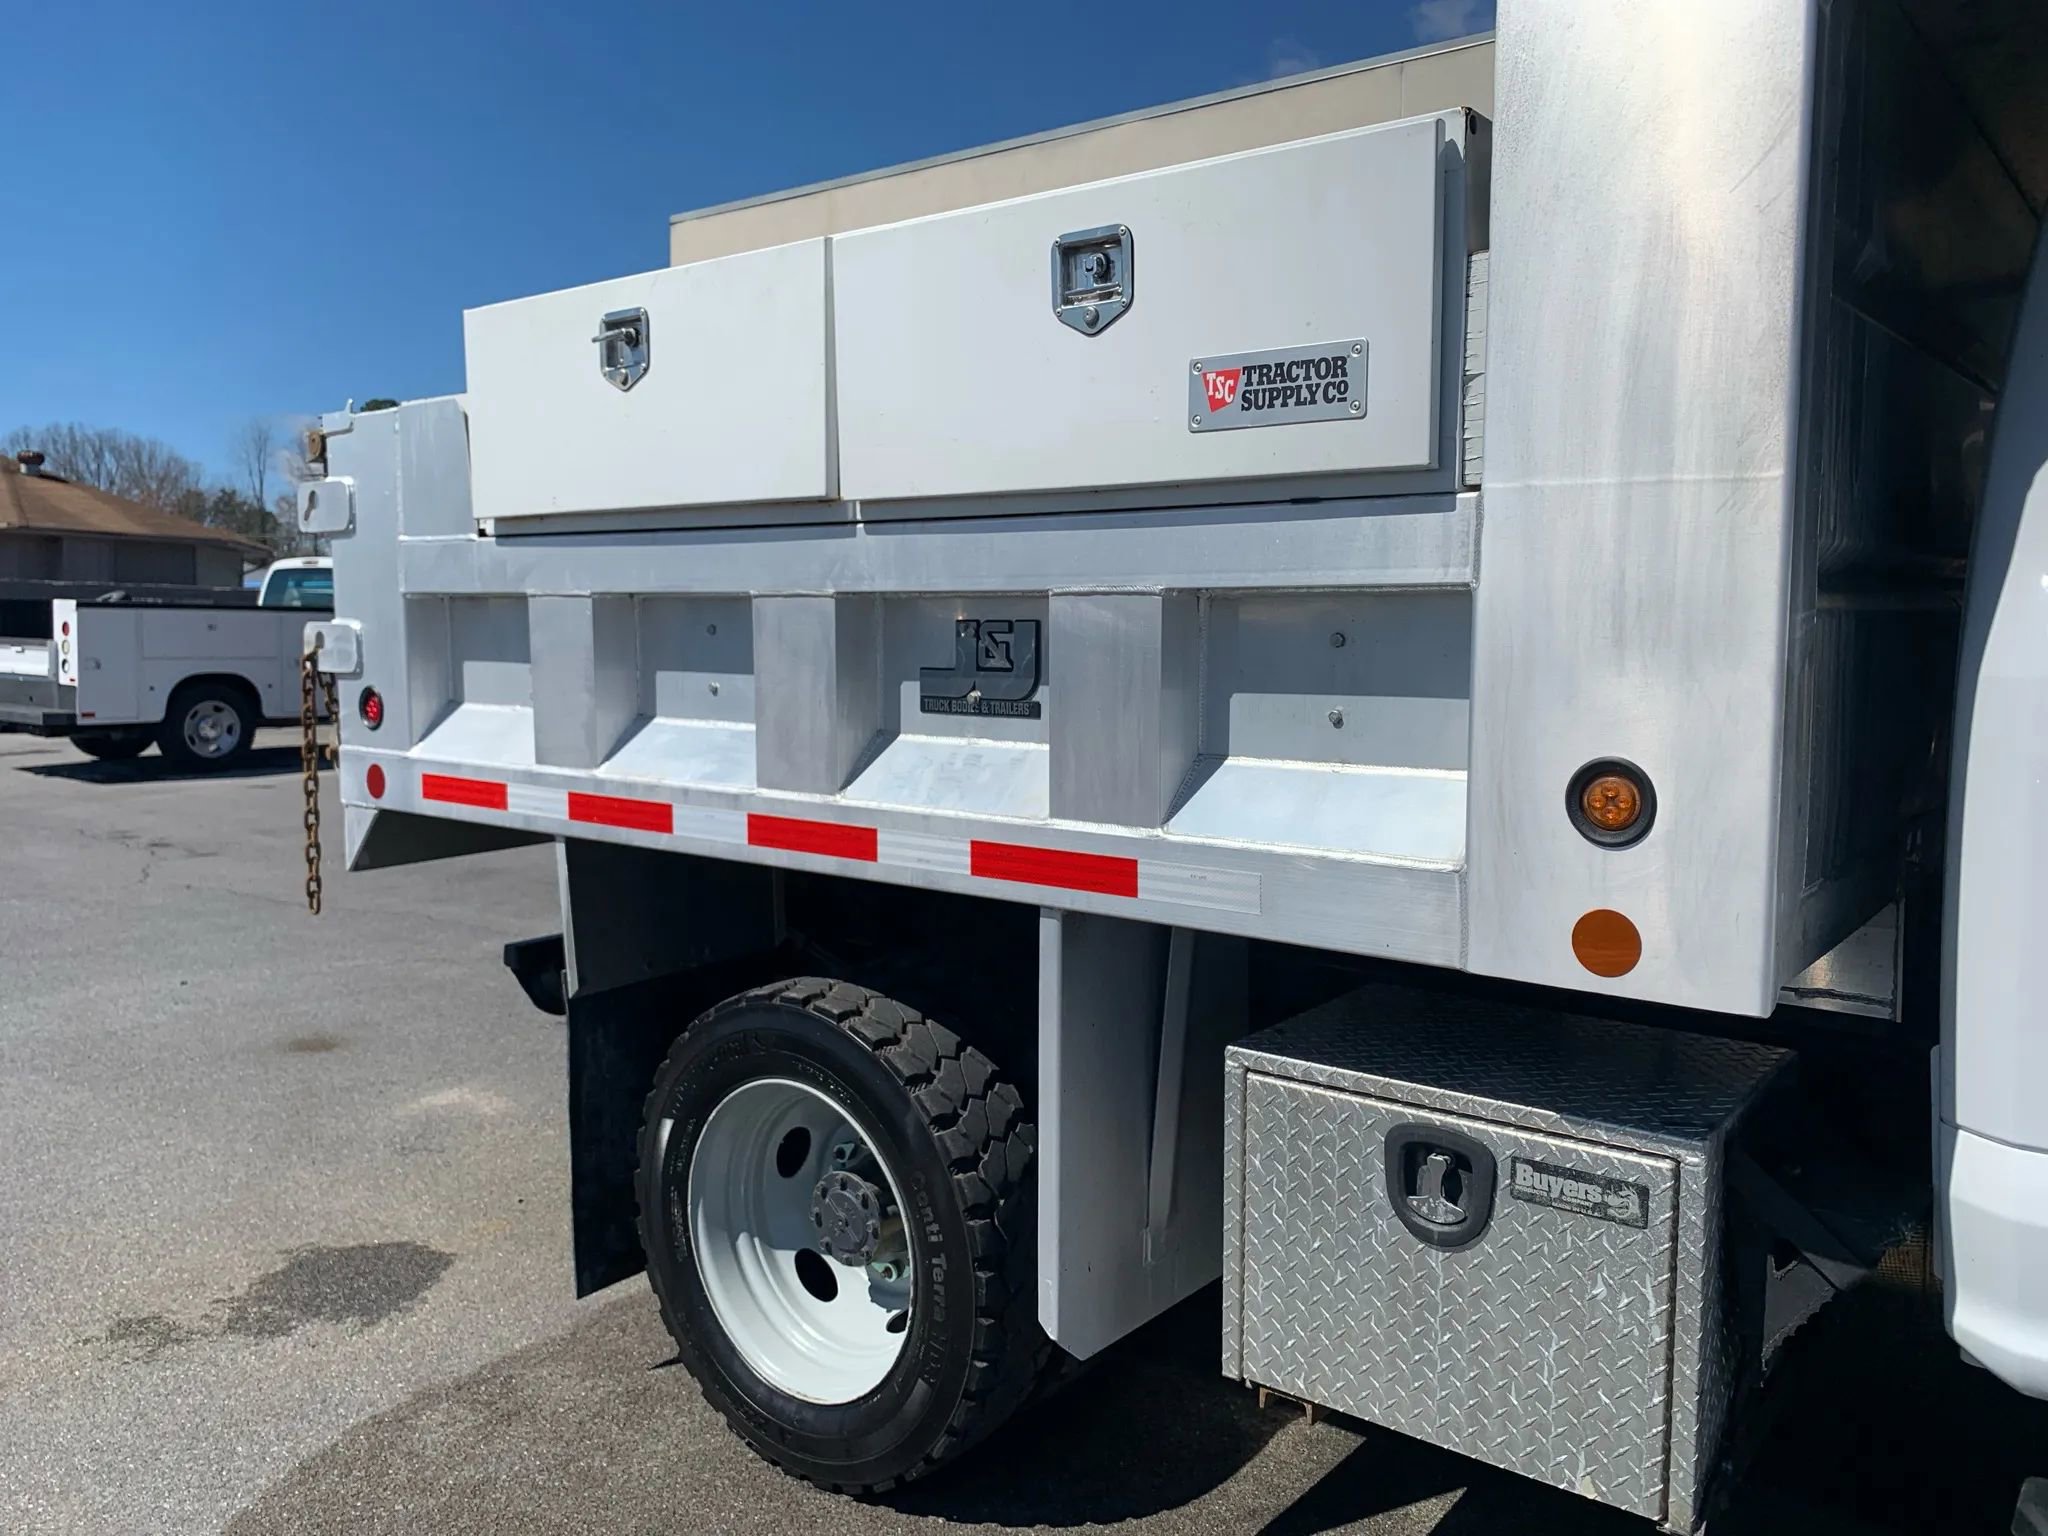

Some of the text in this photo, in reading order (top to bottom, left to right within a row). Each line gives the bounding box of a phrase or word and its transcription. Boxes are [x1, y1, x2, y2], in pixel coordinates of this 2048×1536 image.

[1241, 355, 1349, 387] TRACTOR
[1206, 372, 1234, 403] TSC
[1240, 382, 1322, 412] SUPPLY
[924, 698, 950, 712] TRUCK
[990, 702, 1030, 716] TRAILERS
[1515, 1163, 1602, 1203] Buyers
[931, 1252, 947, 1322] Terra
